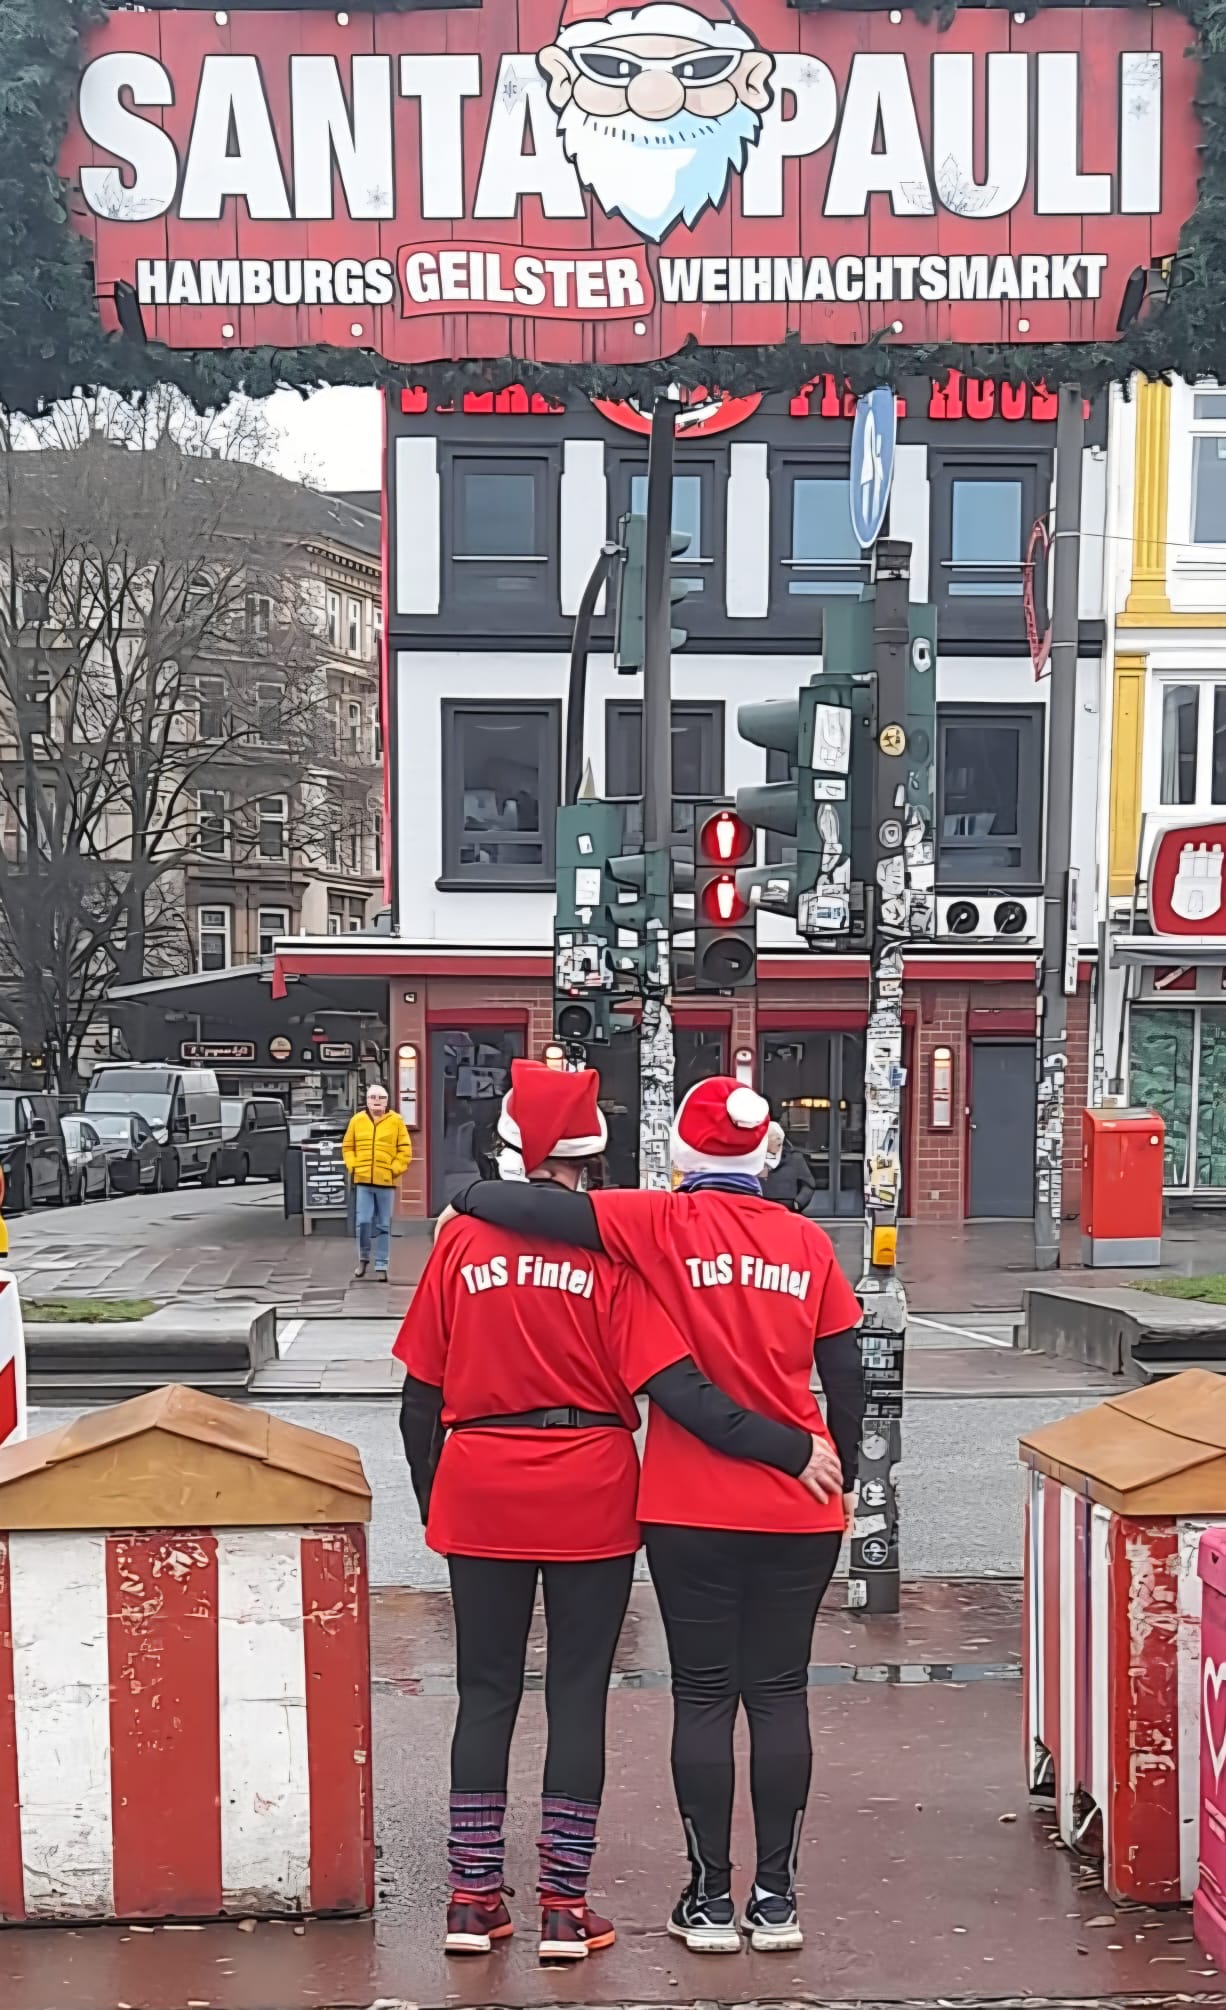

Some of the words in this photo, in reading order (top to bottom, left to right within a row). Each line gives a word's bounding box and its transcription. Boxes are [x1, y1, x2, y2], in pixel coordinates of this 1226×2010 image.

[78, 52, 586, 221] SANTA
[743, 53, 1161, 216] PAULI
[136, 259, 393, 304] HAMBURGS
[405, 250, 644, 309] GEILSTER
[659, 254, 1107, 302] WEIHNACHTSMARKT
[460, 1255, 509, 1294] TuS
[516, 1255, 594, 1299] Fintel
[685, 1253, 733, 1288] TuS
